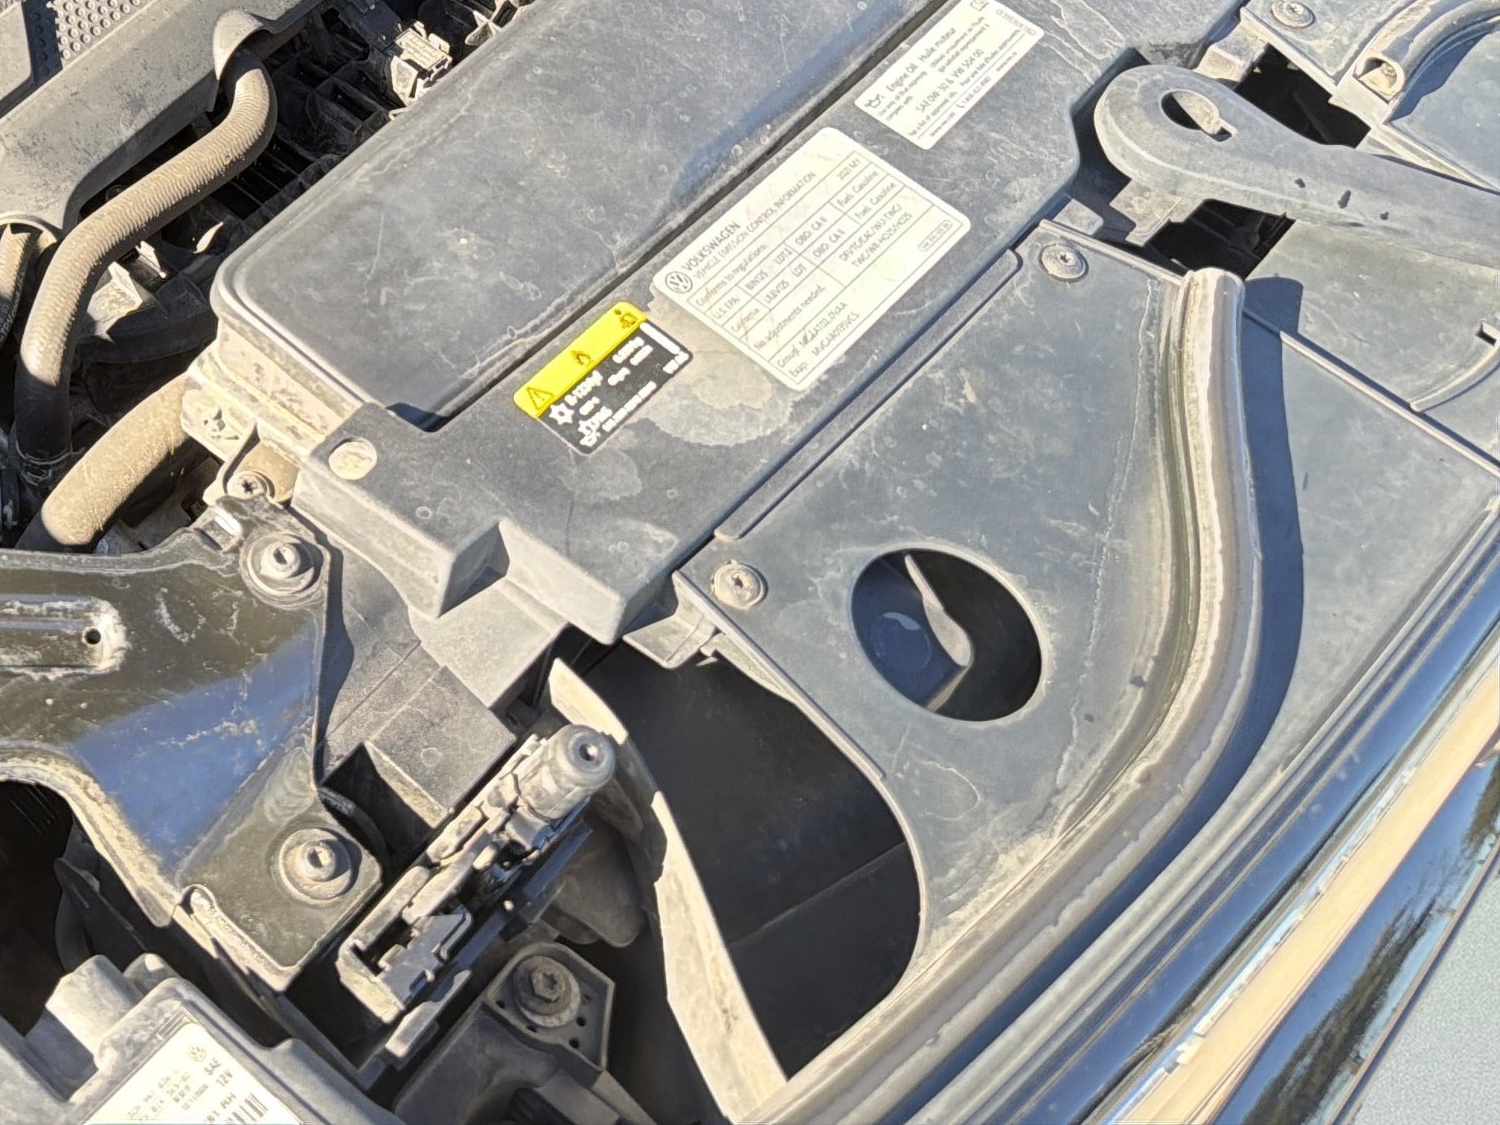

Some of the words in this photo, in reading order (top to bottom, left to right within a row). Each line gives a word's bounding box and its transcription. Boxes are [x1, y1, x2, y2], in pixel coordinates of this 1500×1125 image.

[917, 46, 936, 61] Huile
[934, 27, 956, 47] moteur
[885, 72, 909, 92] Engine
[905, 62, 918, 73] Oil
[851, 170, 879, 193] Gasoline
[869, 182, 896, 205] Gasoline
[681, 221, 740, 270] VOLKSWAGEN
[215, 1070, 234, 1087] 12V
